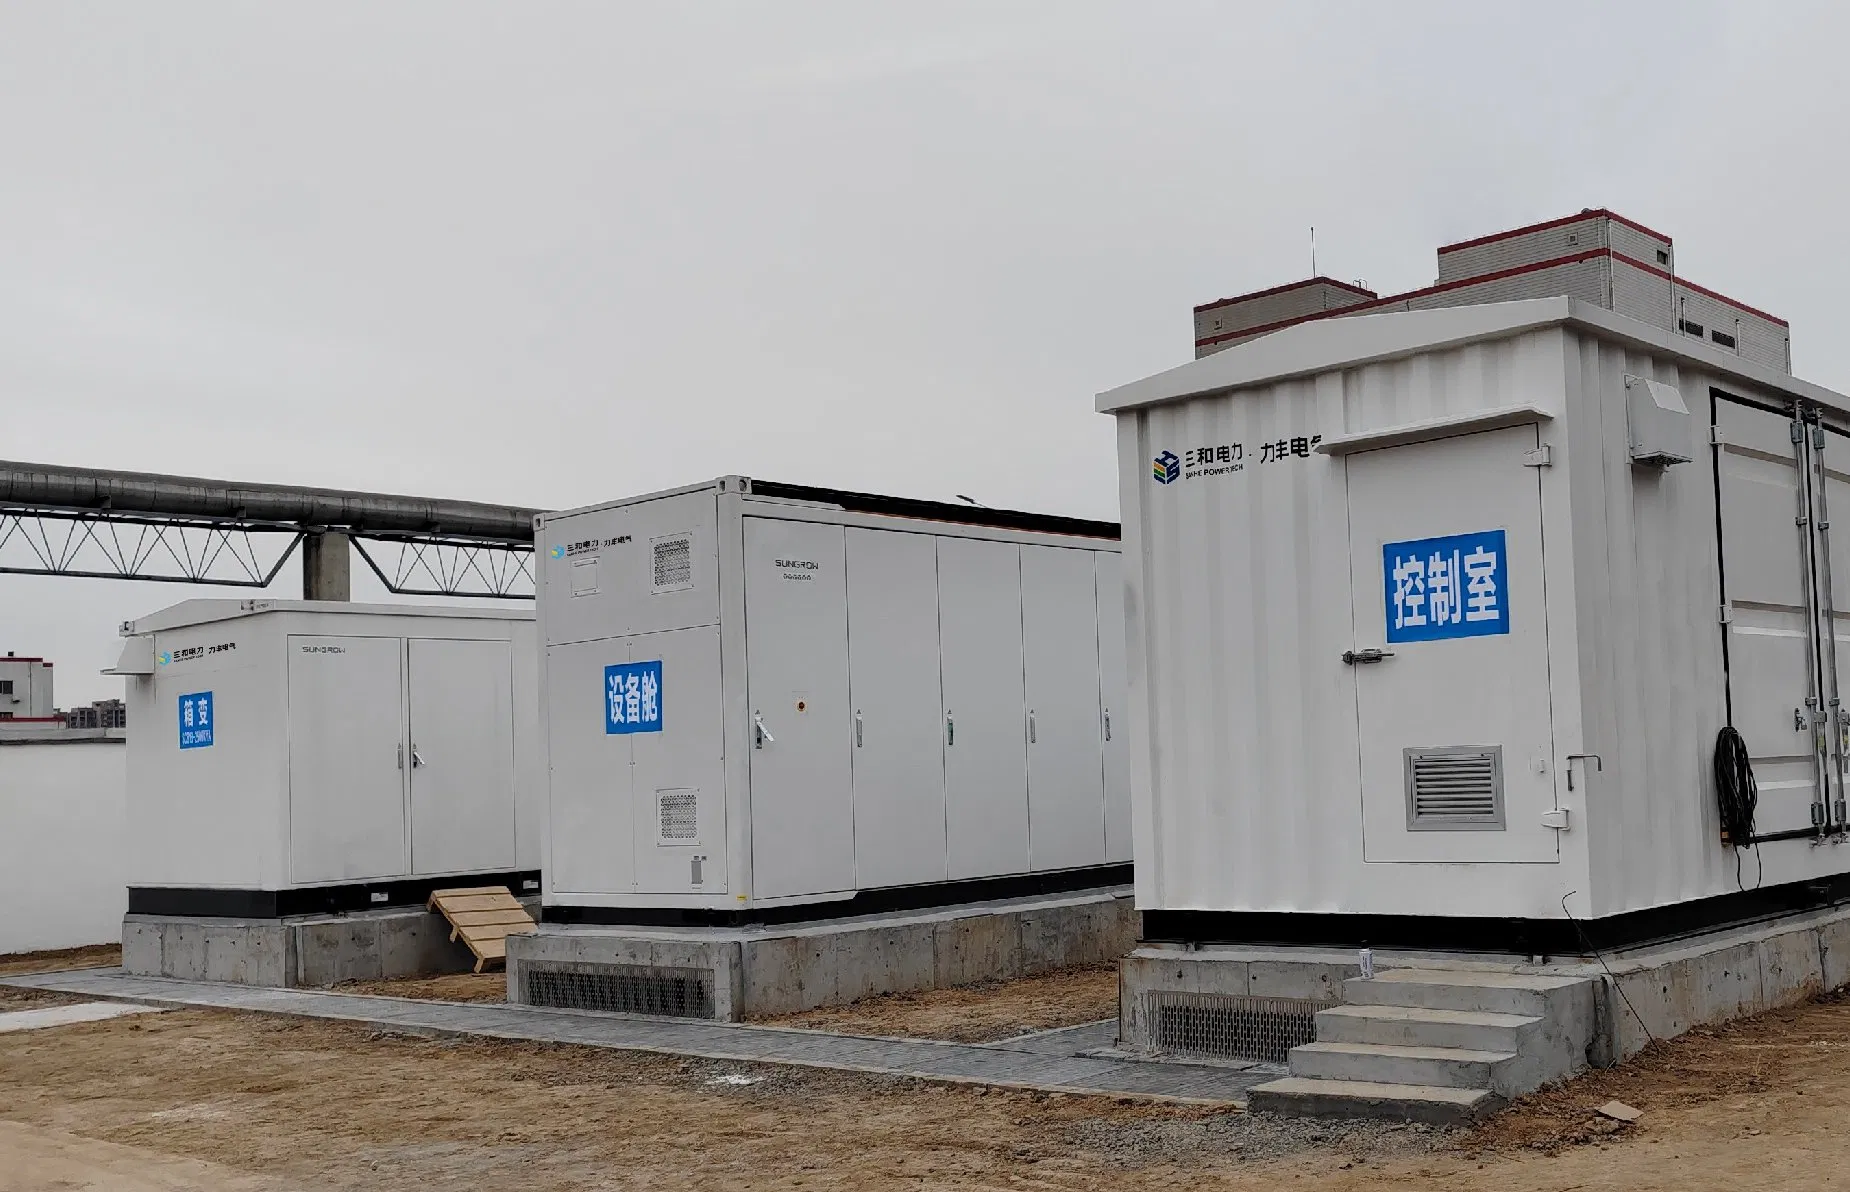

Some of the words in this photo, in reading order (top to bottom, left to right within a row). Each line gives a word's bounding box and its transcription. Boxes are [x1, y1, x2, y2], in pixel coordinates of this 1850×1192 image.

[1186, 442, 1243, 468] 三和电力
[775, 559, 819, 570] SUNGROW
[1392, 545, 1500, 630] 控制室
[608, 670, 658, 725] 设备舱
